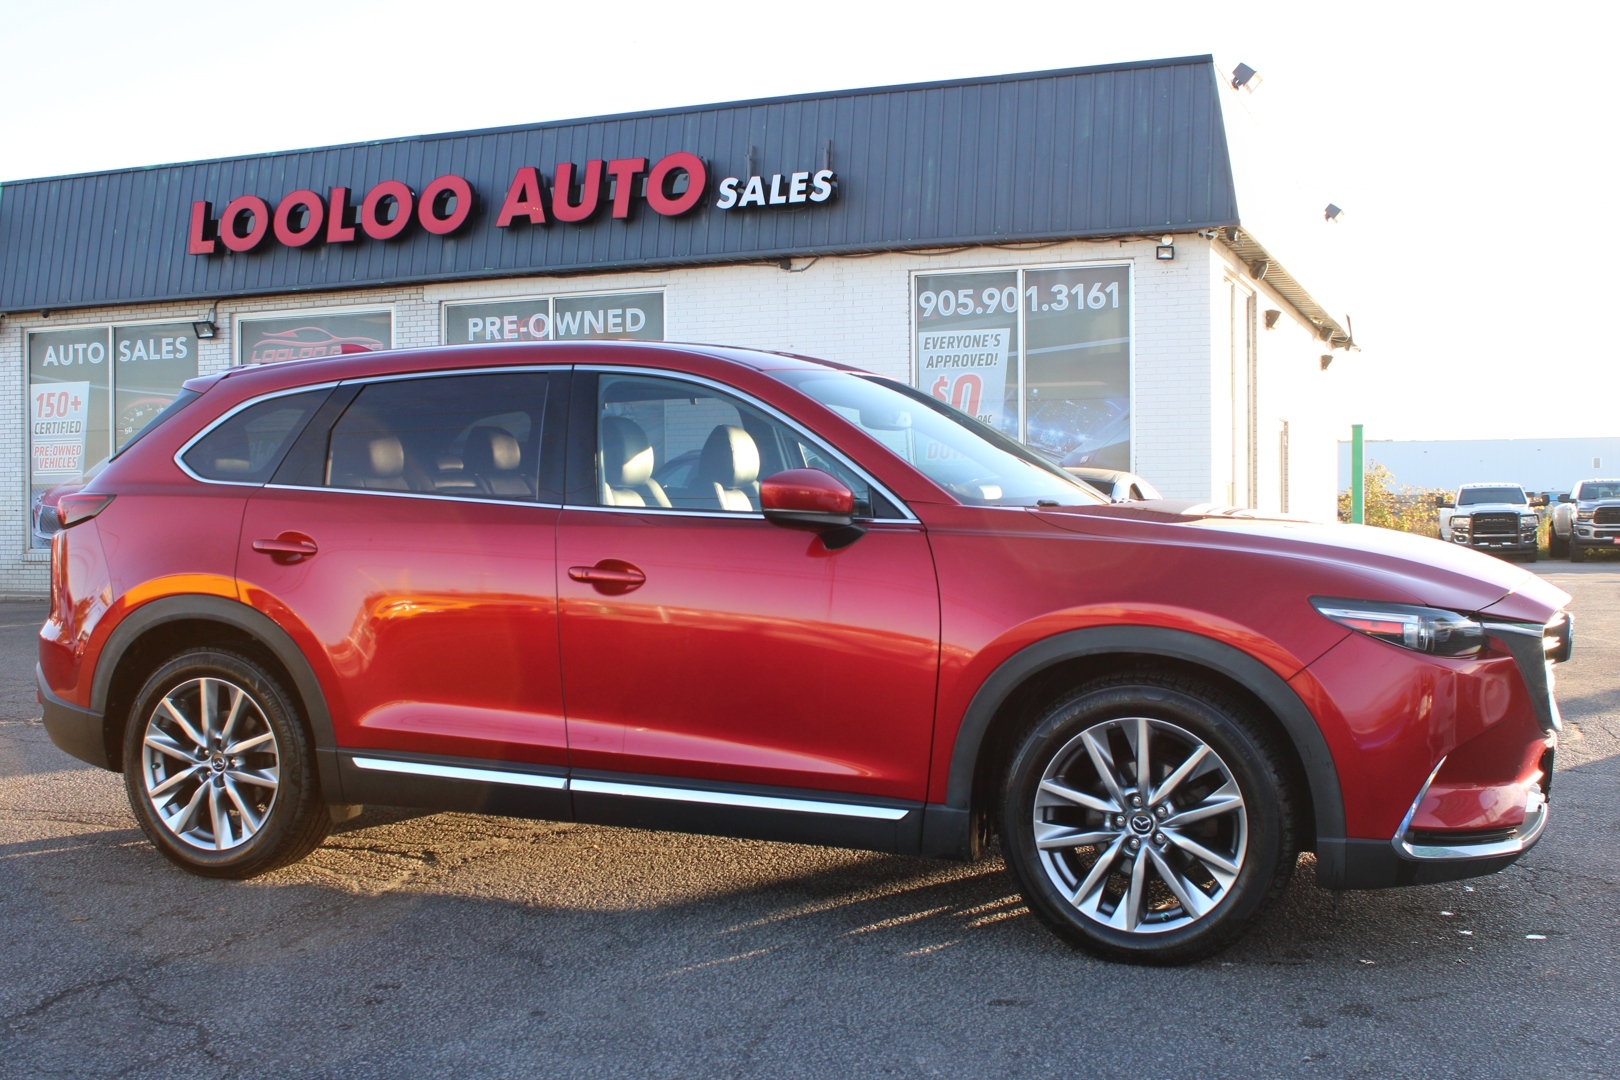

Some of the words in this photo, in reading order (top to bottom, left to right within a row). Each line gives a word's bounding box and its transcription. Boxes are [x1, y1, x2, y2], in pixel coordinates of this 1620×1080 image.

[188, 174, 473, 255] LOOLOO
[495, 152, 708, 228] AUTO
[715, 169, 835, 210] SALES
[918, 281, 1120, 317] 905.901.3161
[468, 307, 646, 341] PRE-OWNED
[42, 342, 105, 367] AUTO
[119, 336, 188, 363] SALES
[923, 333, 1002, 351] EVERYONE'S
[925, 352, 999, 369] APPROVED!
[35, 391, 82, 419] 150+
[932, 373, 982, 418] $0
[34, 420, 82, 435] CERTIFIED
[33, 444, 82, 457] PRE-OWNED
[38, 456, 77, 469] VEHICLES
